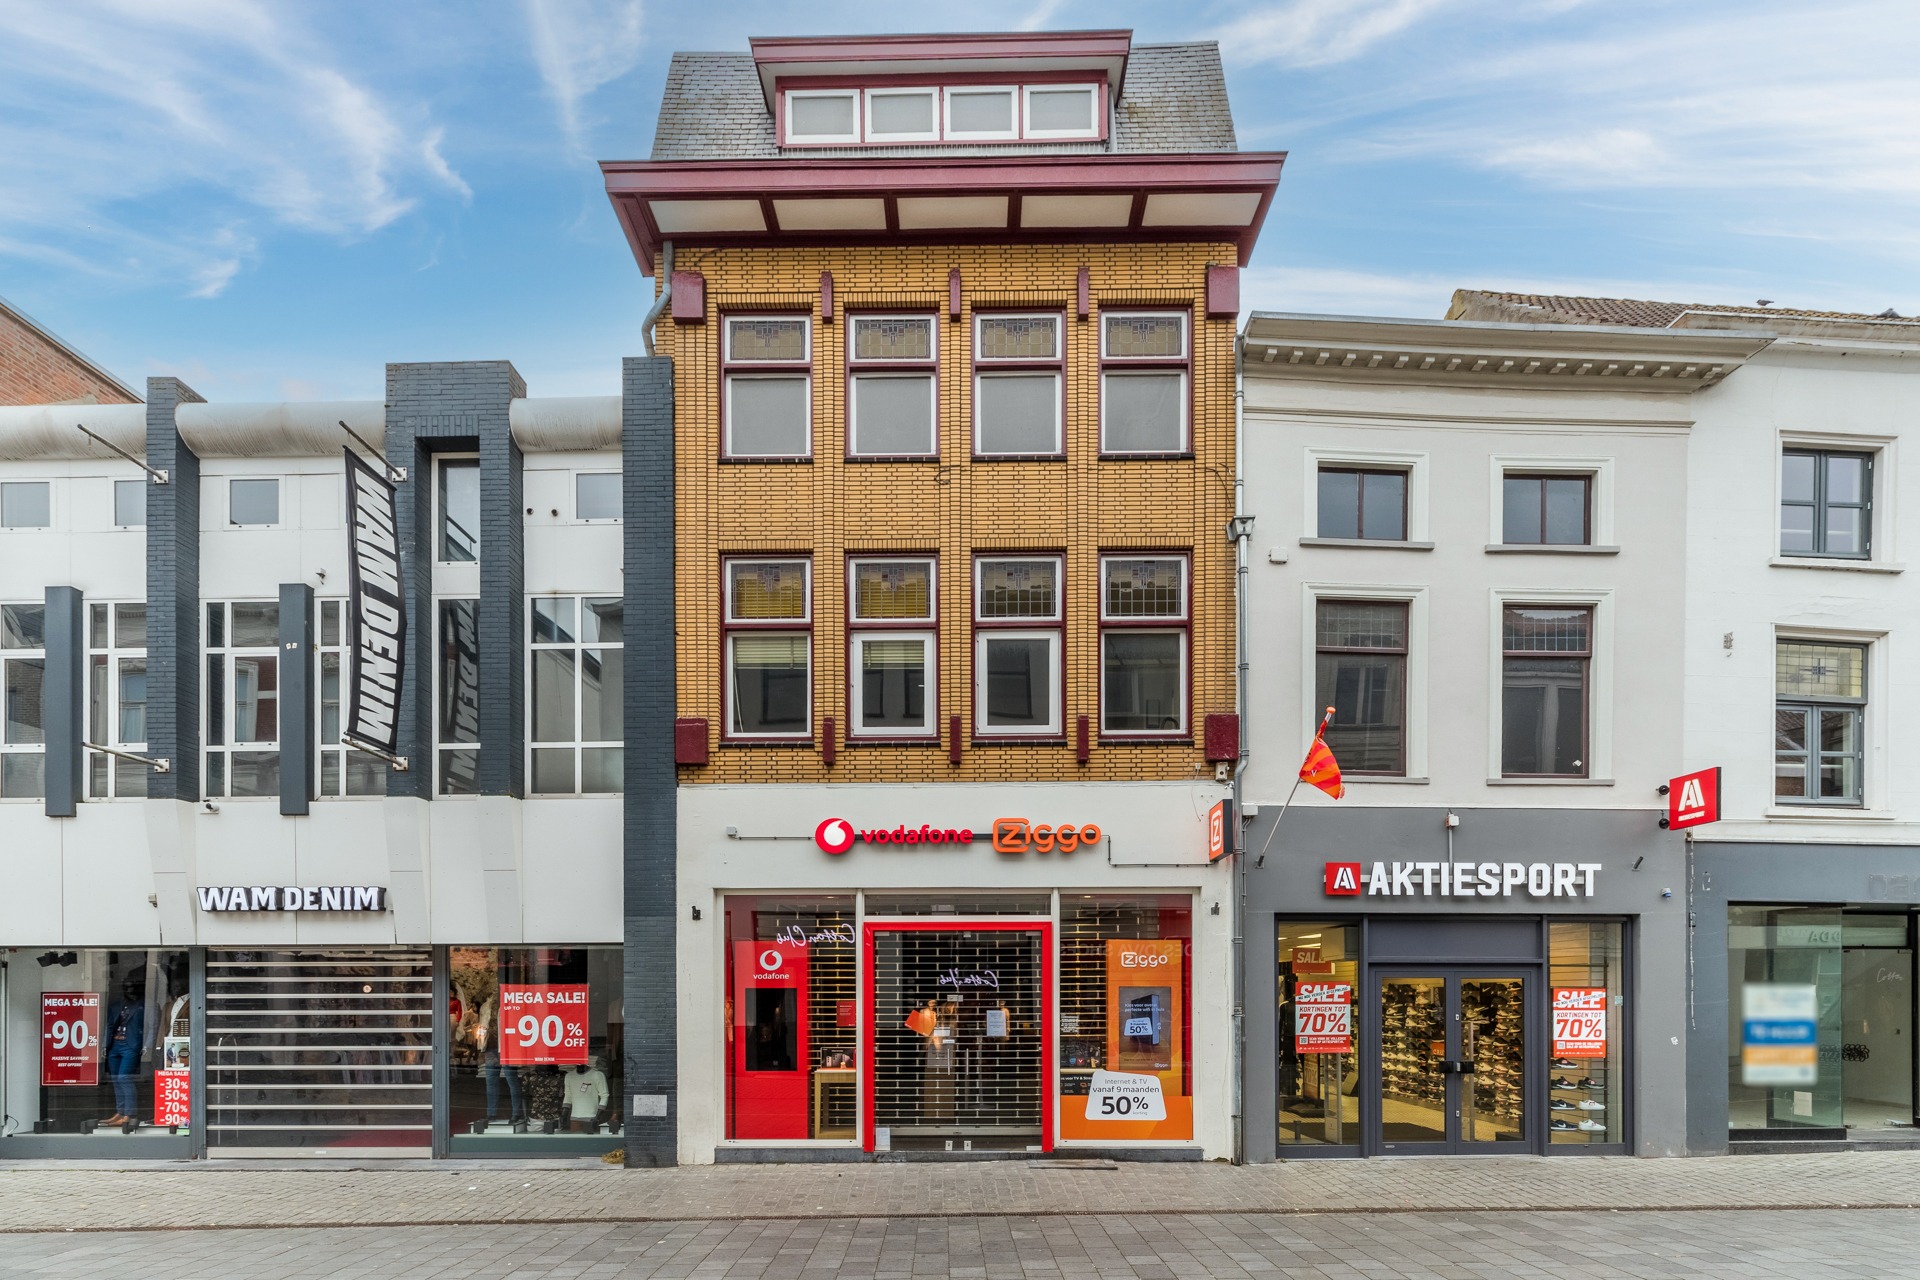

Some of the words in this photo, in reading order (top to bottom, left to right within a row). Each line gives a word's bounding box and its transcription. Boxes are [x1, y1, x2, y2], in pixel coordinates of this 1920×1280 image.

[354, 467, 399, 597] WAM
[356, 590, 400, 745] DENIM
[861, 825, 973, 845] vodafone
[1368, 861, 1602, 897] AKTIESPORT
[196, 886, 277, 911] WAM
[283, 886, 382, 911] DENIM
[44, 998, 71, 1006] MEGA
[72, 998, 97, 1006] SALE!
[504, 992, 543, 1003] MEGA
[546, 992, 585, 1003] SALE!
[1300, 984, 1347, 1002] SALE
[1557, 991, 1602, 1008] SALE
[1130, 1026, 1148, 1034] 50%
[1299, 1013, 1346, 1032] 70%
[1556, 1019, 1602, 1038] 70%
[564, 1038, 585, 1047] OFF
[160, 1078, 188, 1089] -30%
[160, 1090, 188, 1101] -50%
[160, 1102, 188, 1113] -70%
[1101, 1096, 1148, 1115] 50%
